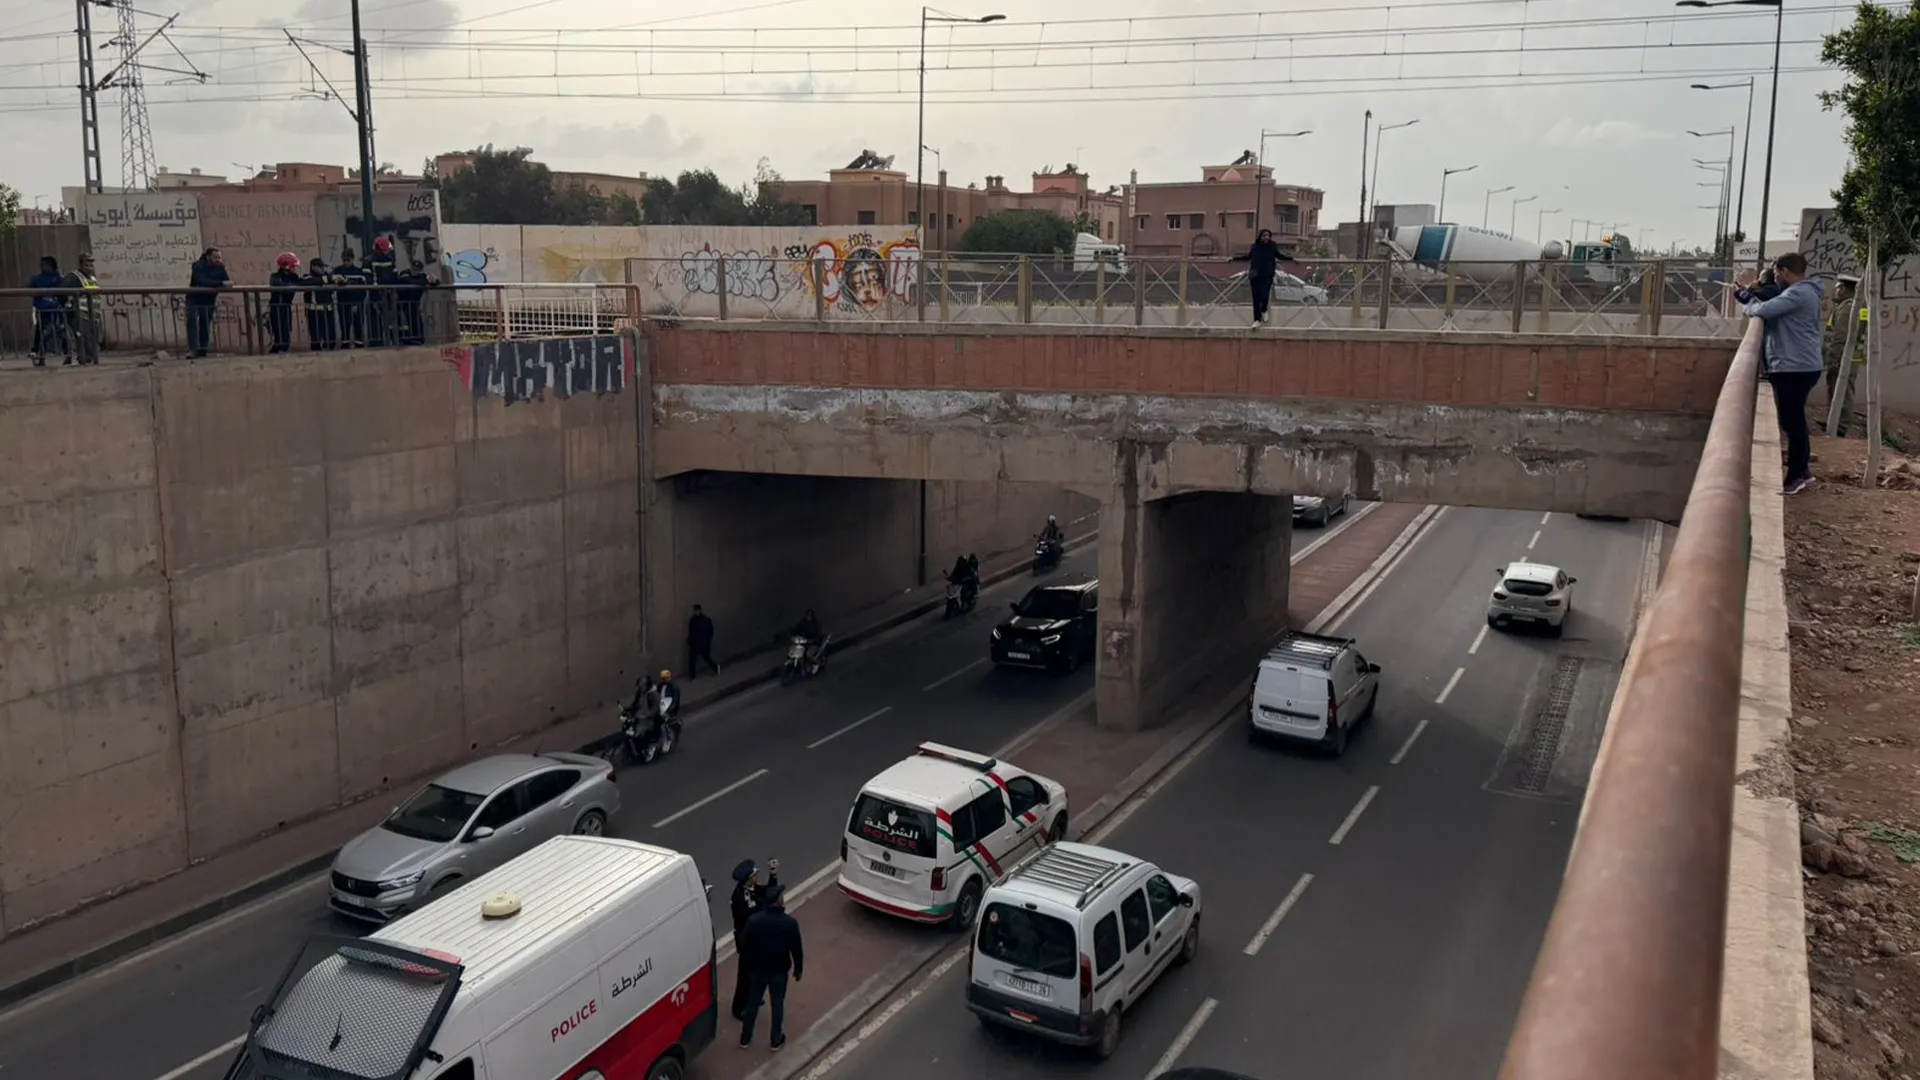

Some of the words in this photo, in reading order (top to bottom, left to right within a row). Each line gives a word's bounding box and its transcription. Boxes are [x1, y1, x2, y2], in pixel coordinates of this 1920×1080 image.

[134, 198, 196, 228] مؤسسة
[201, 204, 252, 218] CABINET
[258, 204, 313, 219] DENTAIRE
[863, 826, 917, 850] POLICE
[864, 816, 919, 840] الشرطة
[612, 958, 653, 998] الشرطة
[551, 1000, 597, 1043] POLICE
